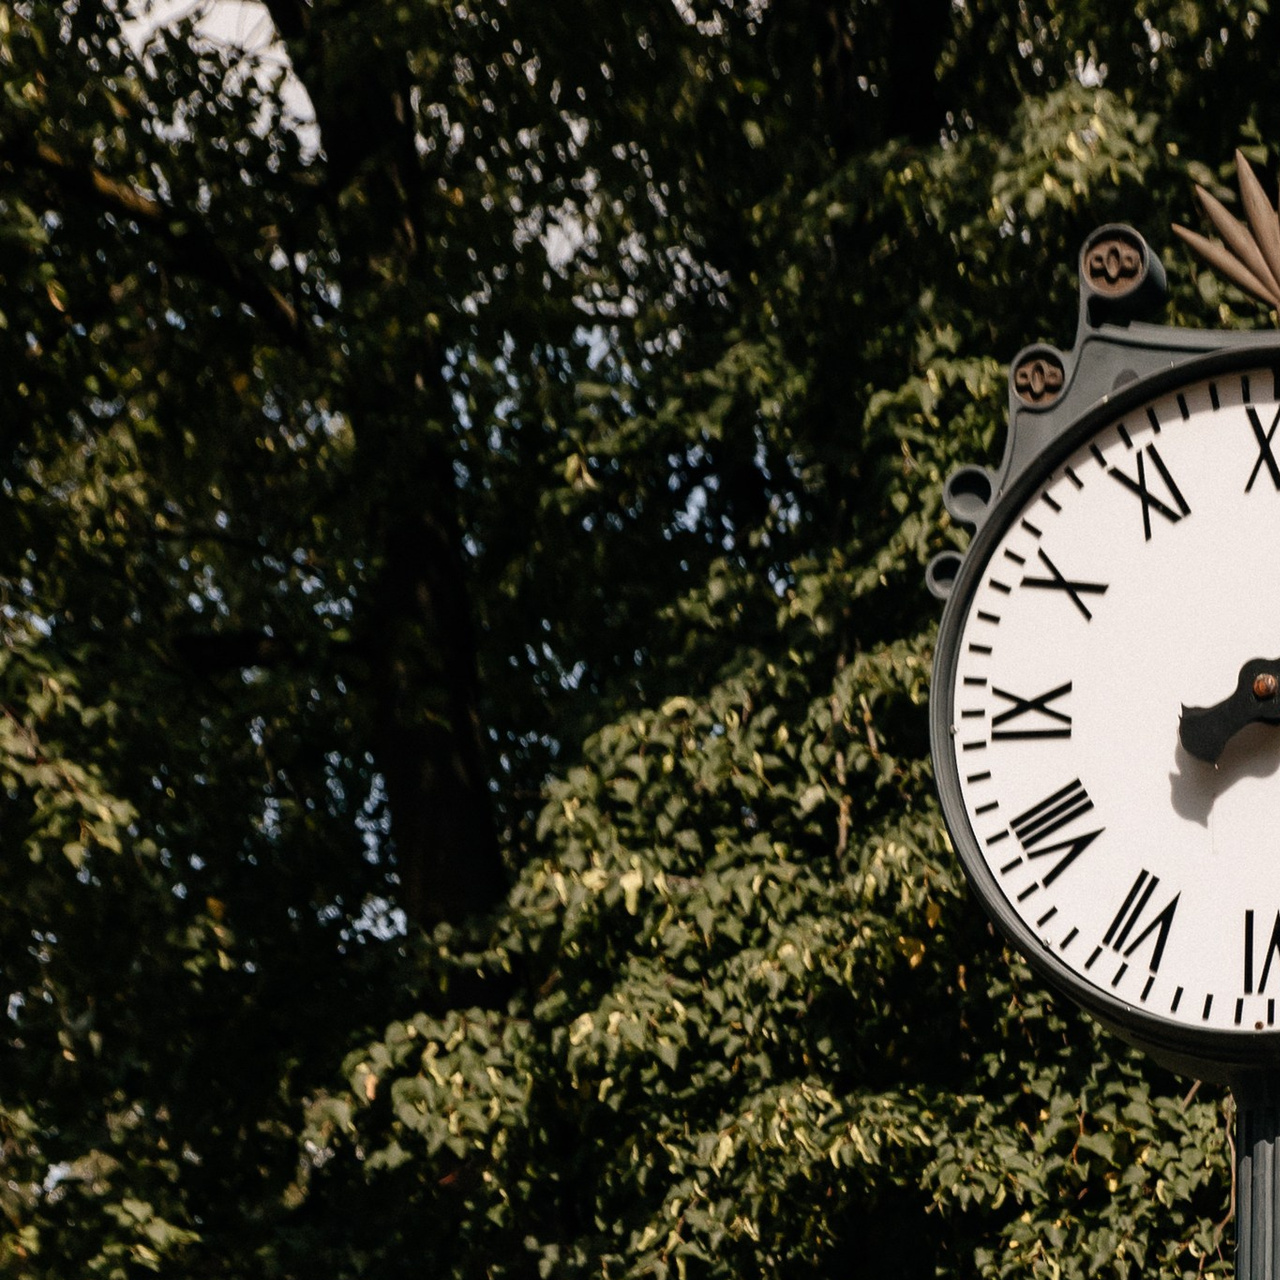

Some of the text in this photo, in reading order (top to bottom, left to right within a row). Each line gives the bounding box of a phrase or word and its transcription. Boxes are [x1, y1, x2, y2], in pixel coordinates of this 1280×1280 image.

[1107, 442, 1192, 542] XI
[1019, 547, 1109, 622] X
[991, 681, 1073, 742] IX
[1009, 778, 1106, 889] VIII
[1102, 868, 1182, 974] VII
